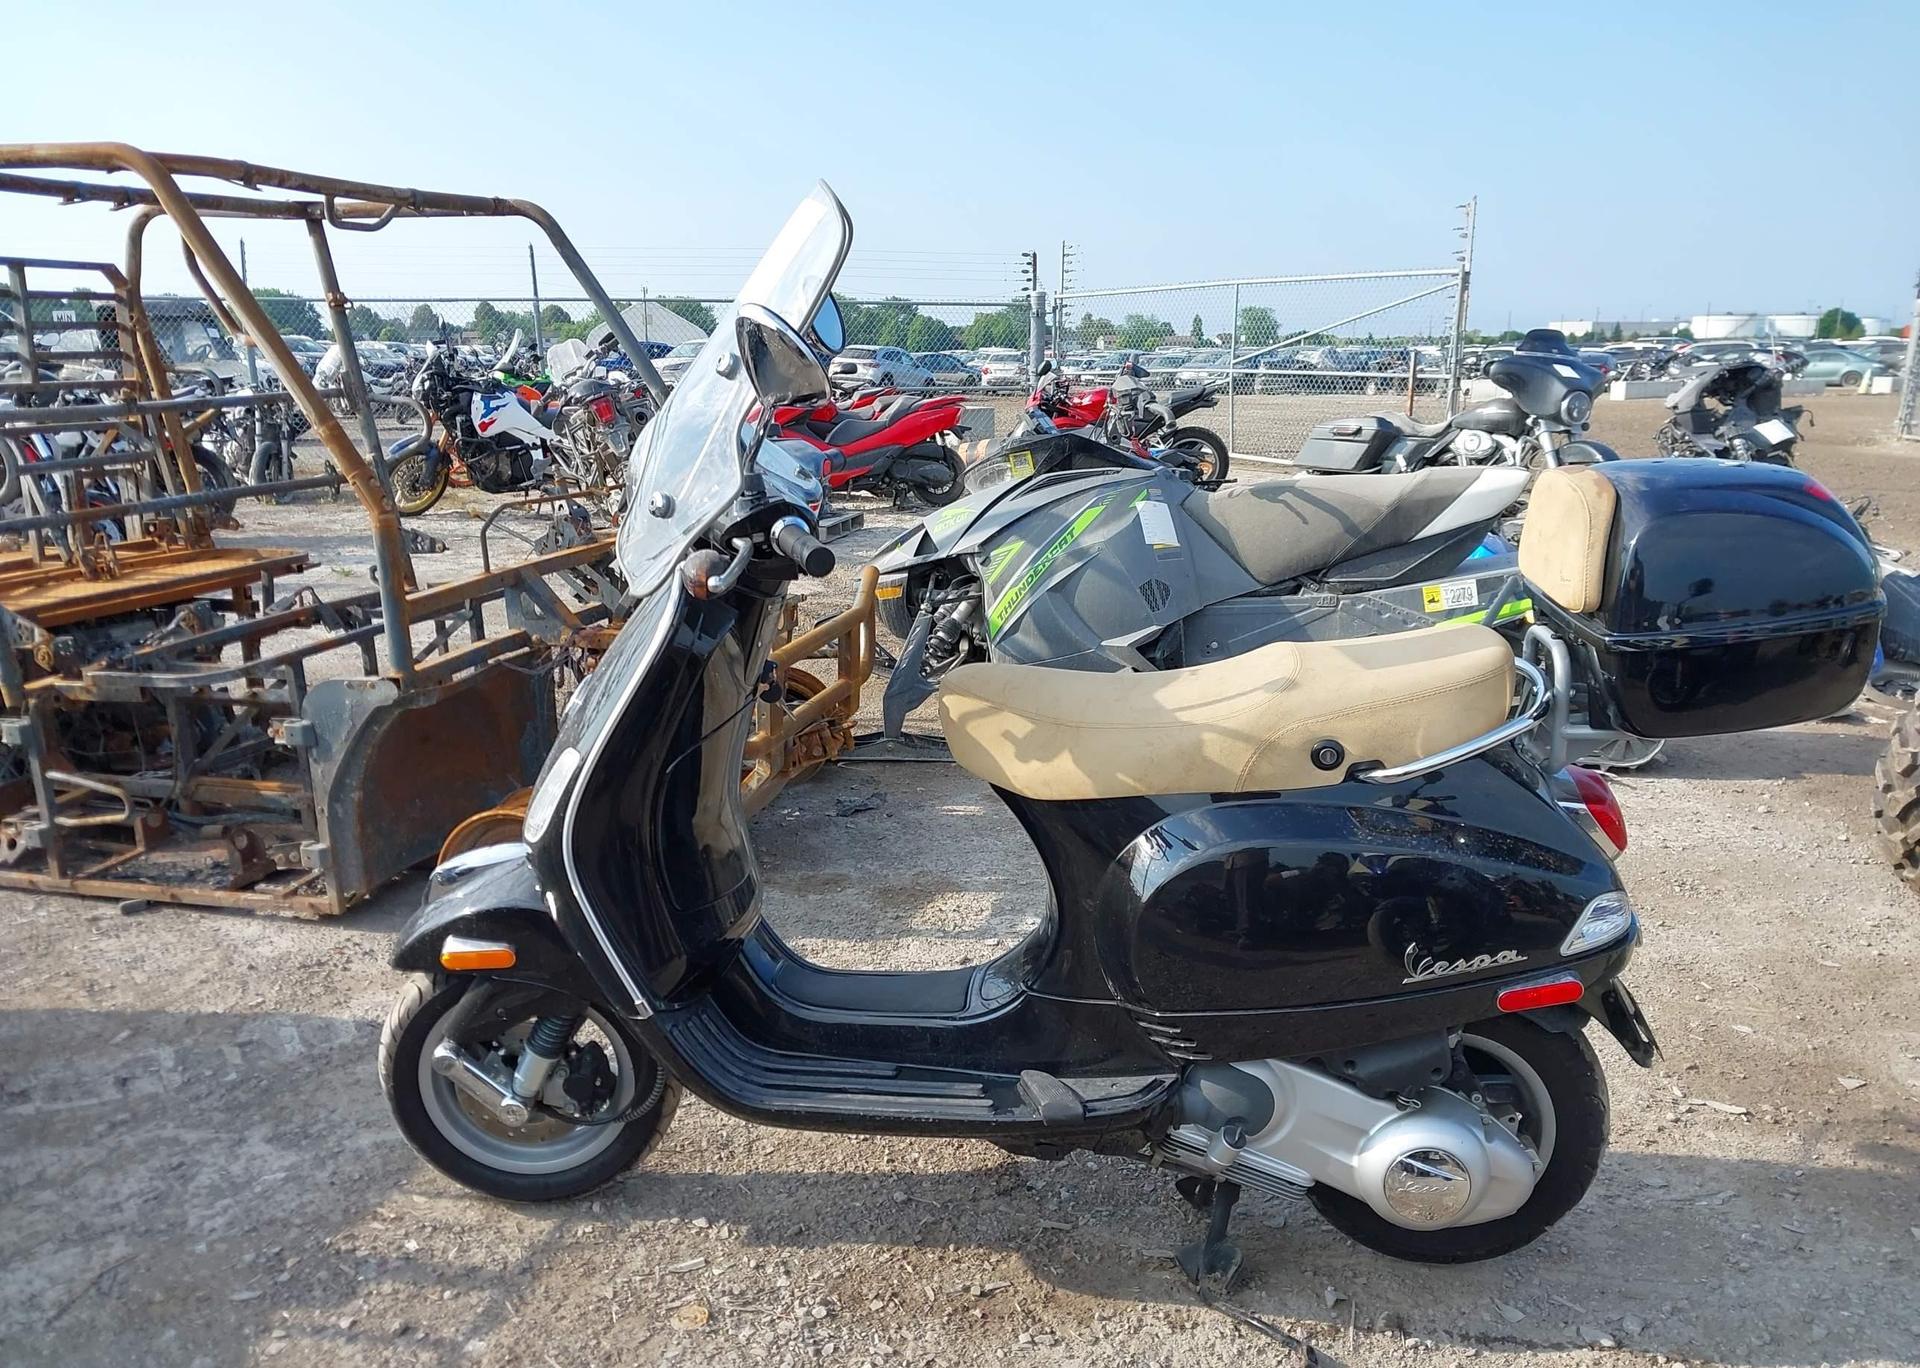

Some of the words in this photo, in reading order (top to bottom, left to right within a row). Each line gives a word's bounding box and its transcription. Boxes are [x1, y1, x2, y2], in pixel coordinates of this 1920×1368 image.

[997, 526, 1076, 622] THUNDERCAT
[1450, 586, 1474, 604] 2279
[1402, 942, 1528, 984] Vespa
